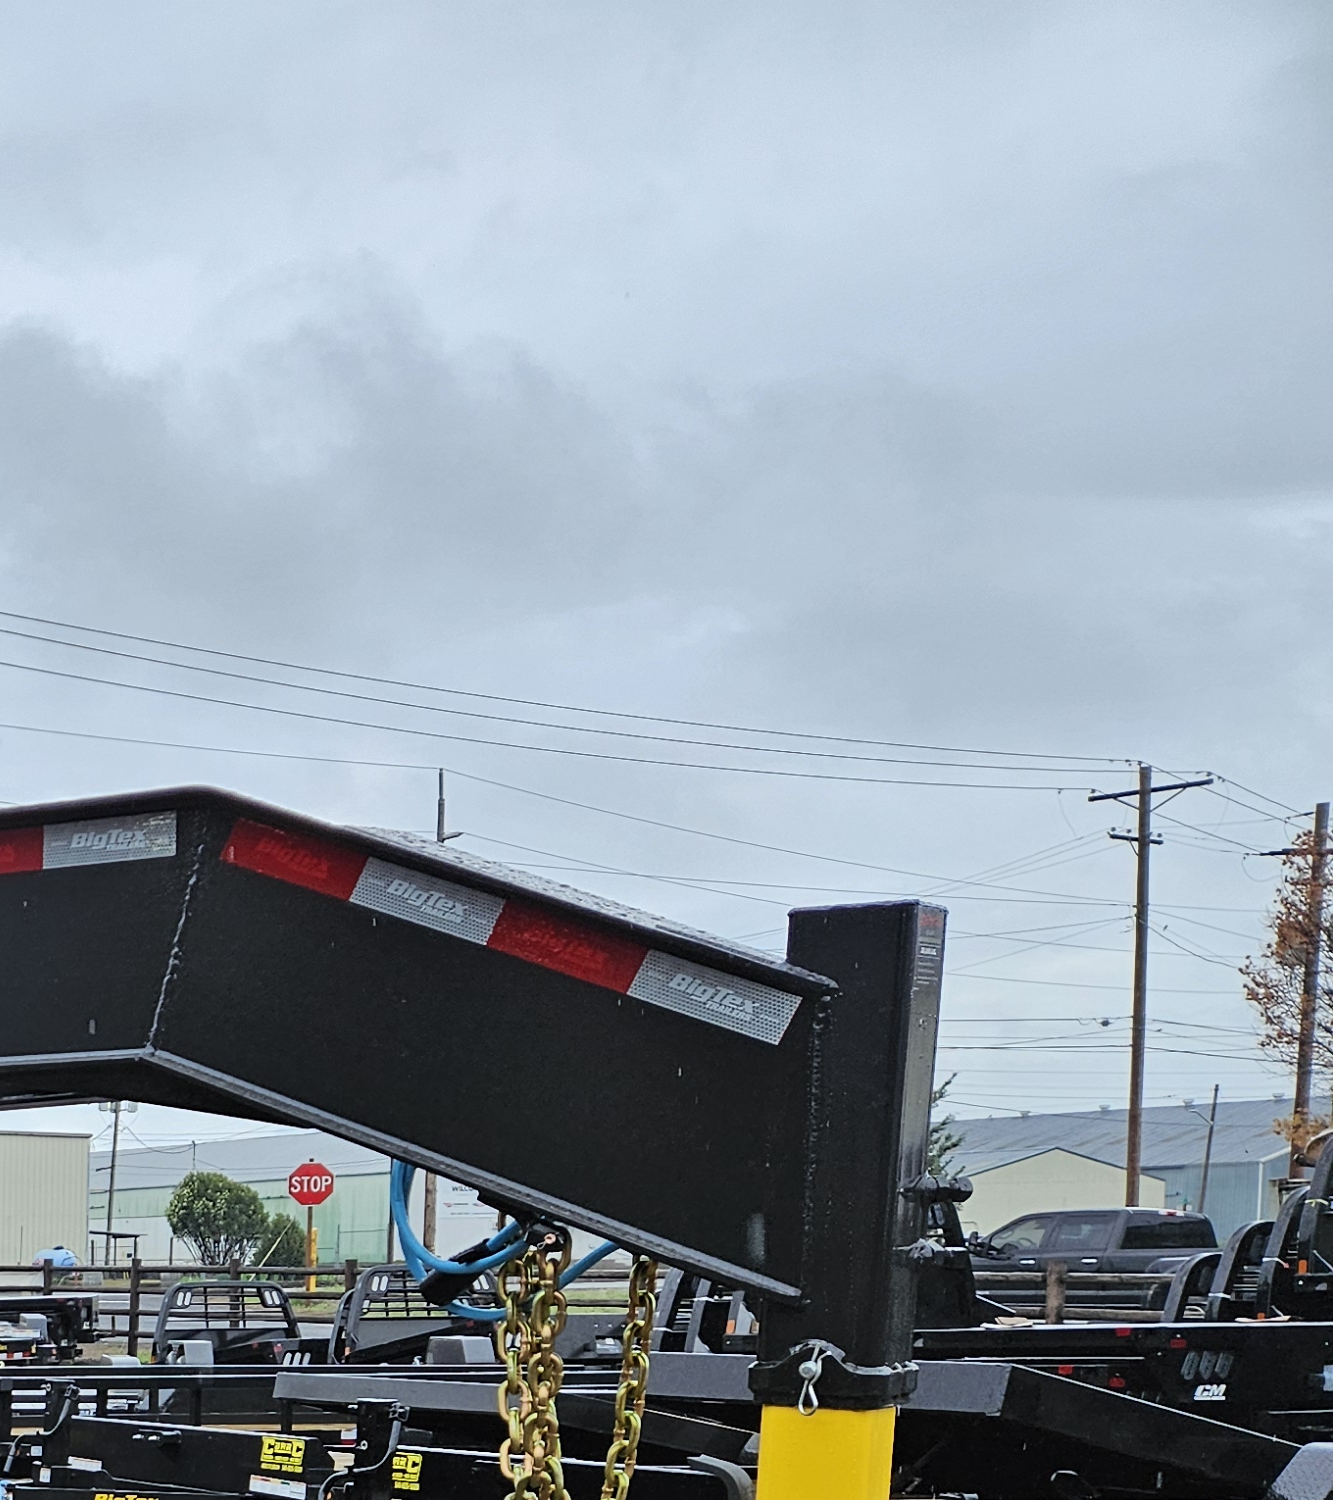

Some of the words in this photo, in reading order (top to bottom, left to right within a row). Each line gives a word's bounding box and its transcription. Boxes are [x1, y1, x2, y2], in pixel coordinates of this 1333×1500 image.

[70, 829, 147, 849] BigTex
[386, 878, 468, 917] BigTex
[668, 973, 760, 1013] BigTex
[290, 1175, 333, 1194] STOP
[1195, 1384, 1227, 1396] CM
